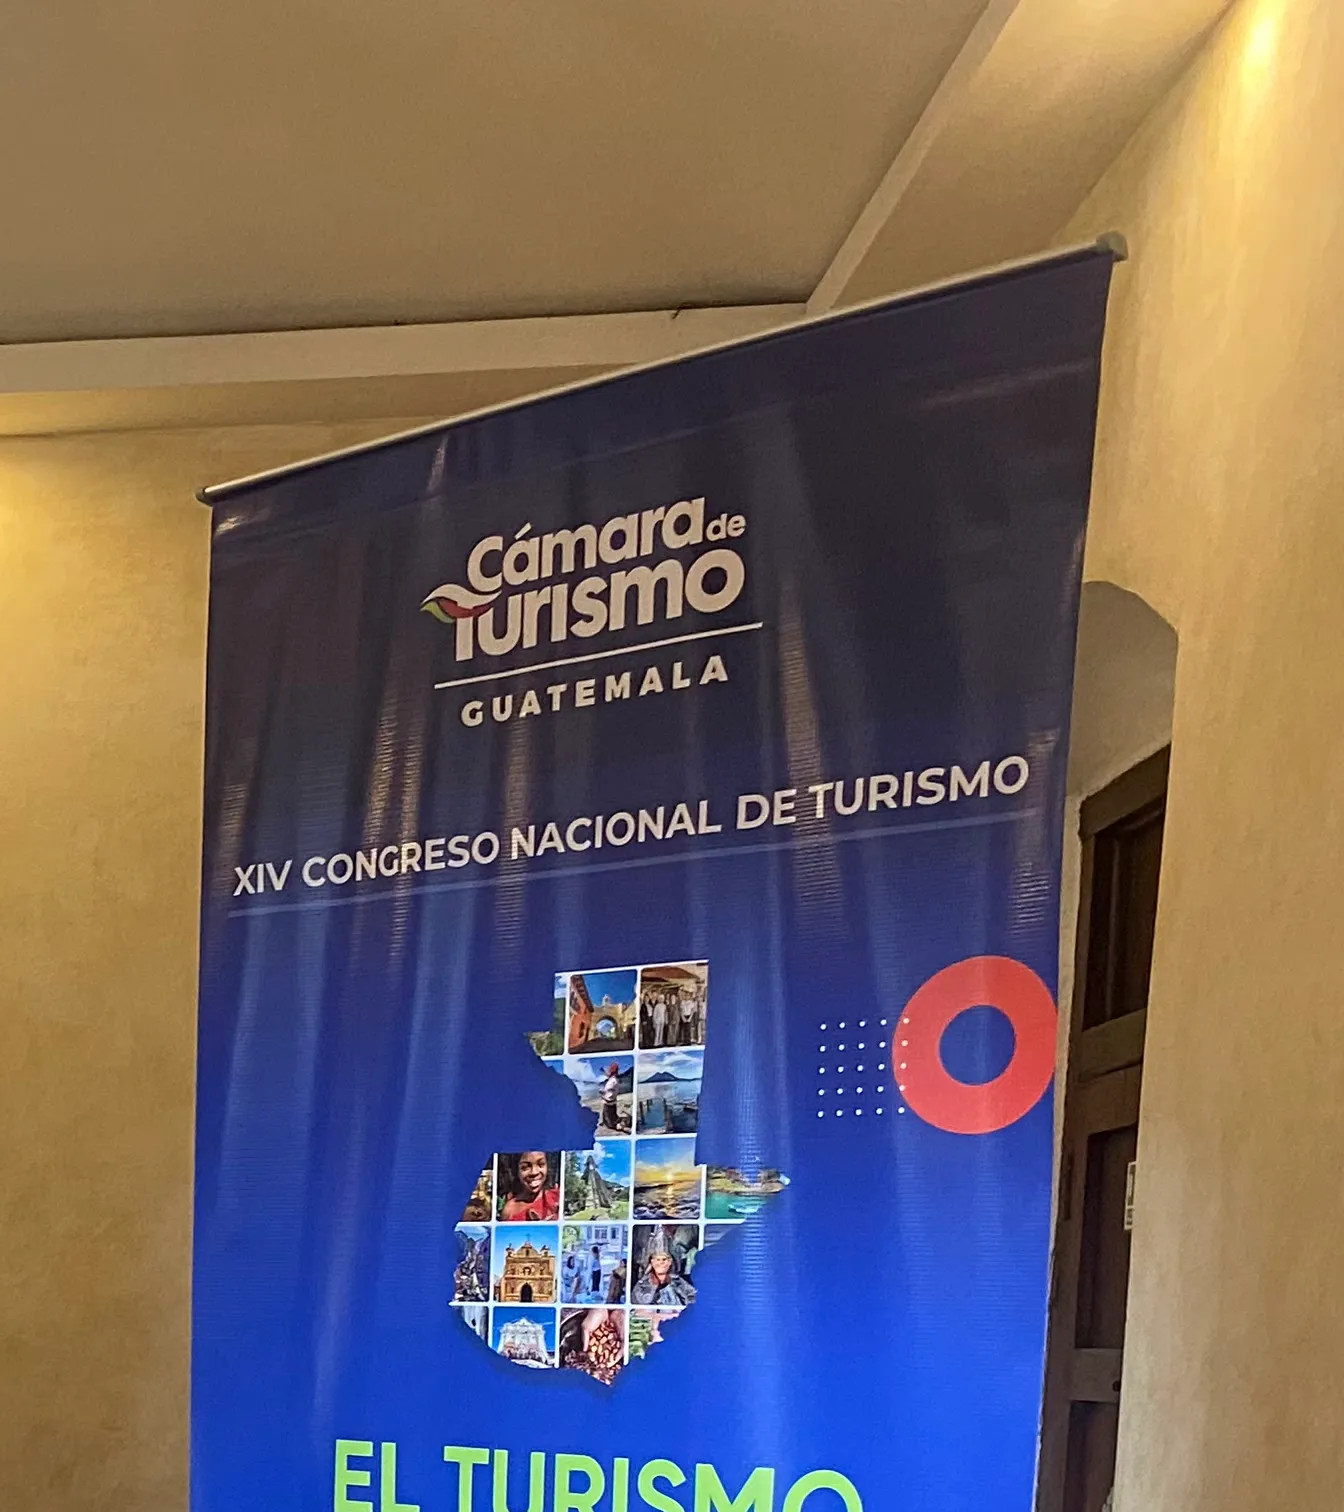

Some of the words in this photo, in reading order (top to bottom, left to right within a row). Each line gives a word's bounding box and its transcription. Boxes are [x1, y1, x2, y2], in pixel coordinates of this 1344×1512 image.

[467, 497, 705, 592] Cámara
[706, 512, 746, 541] de
[461, 655, 729, 727] GUATEMALA
[233, 859, 292, 896] XIV
[302, 831, 500, 888] CONGRESO
[511, 800, 722, 860] NACIONAL
[736, 787, 798, 830] DE
[809, 755, 1030, 818] TURISMO
